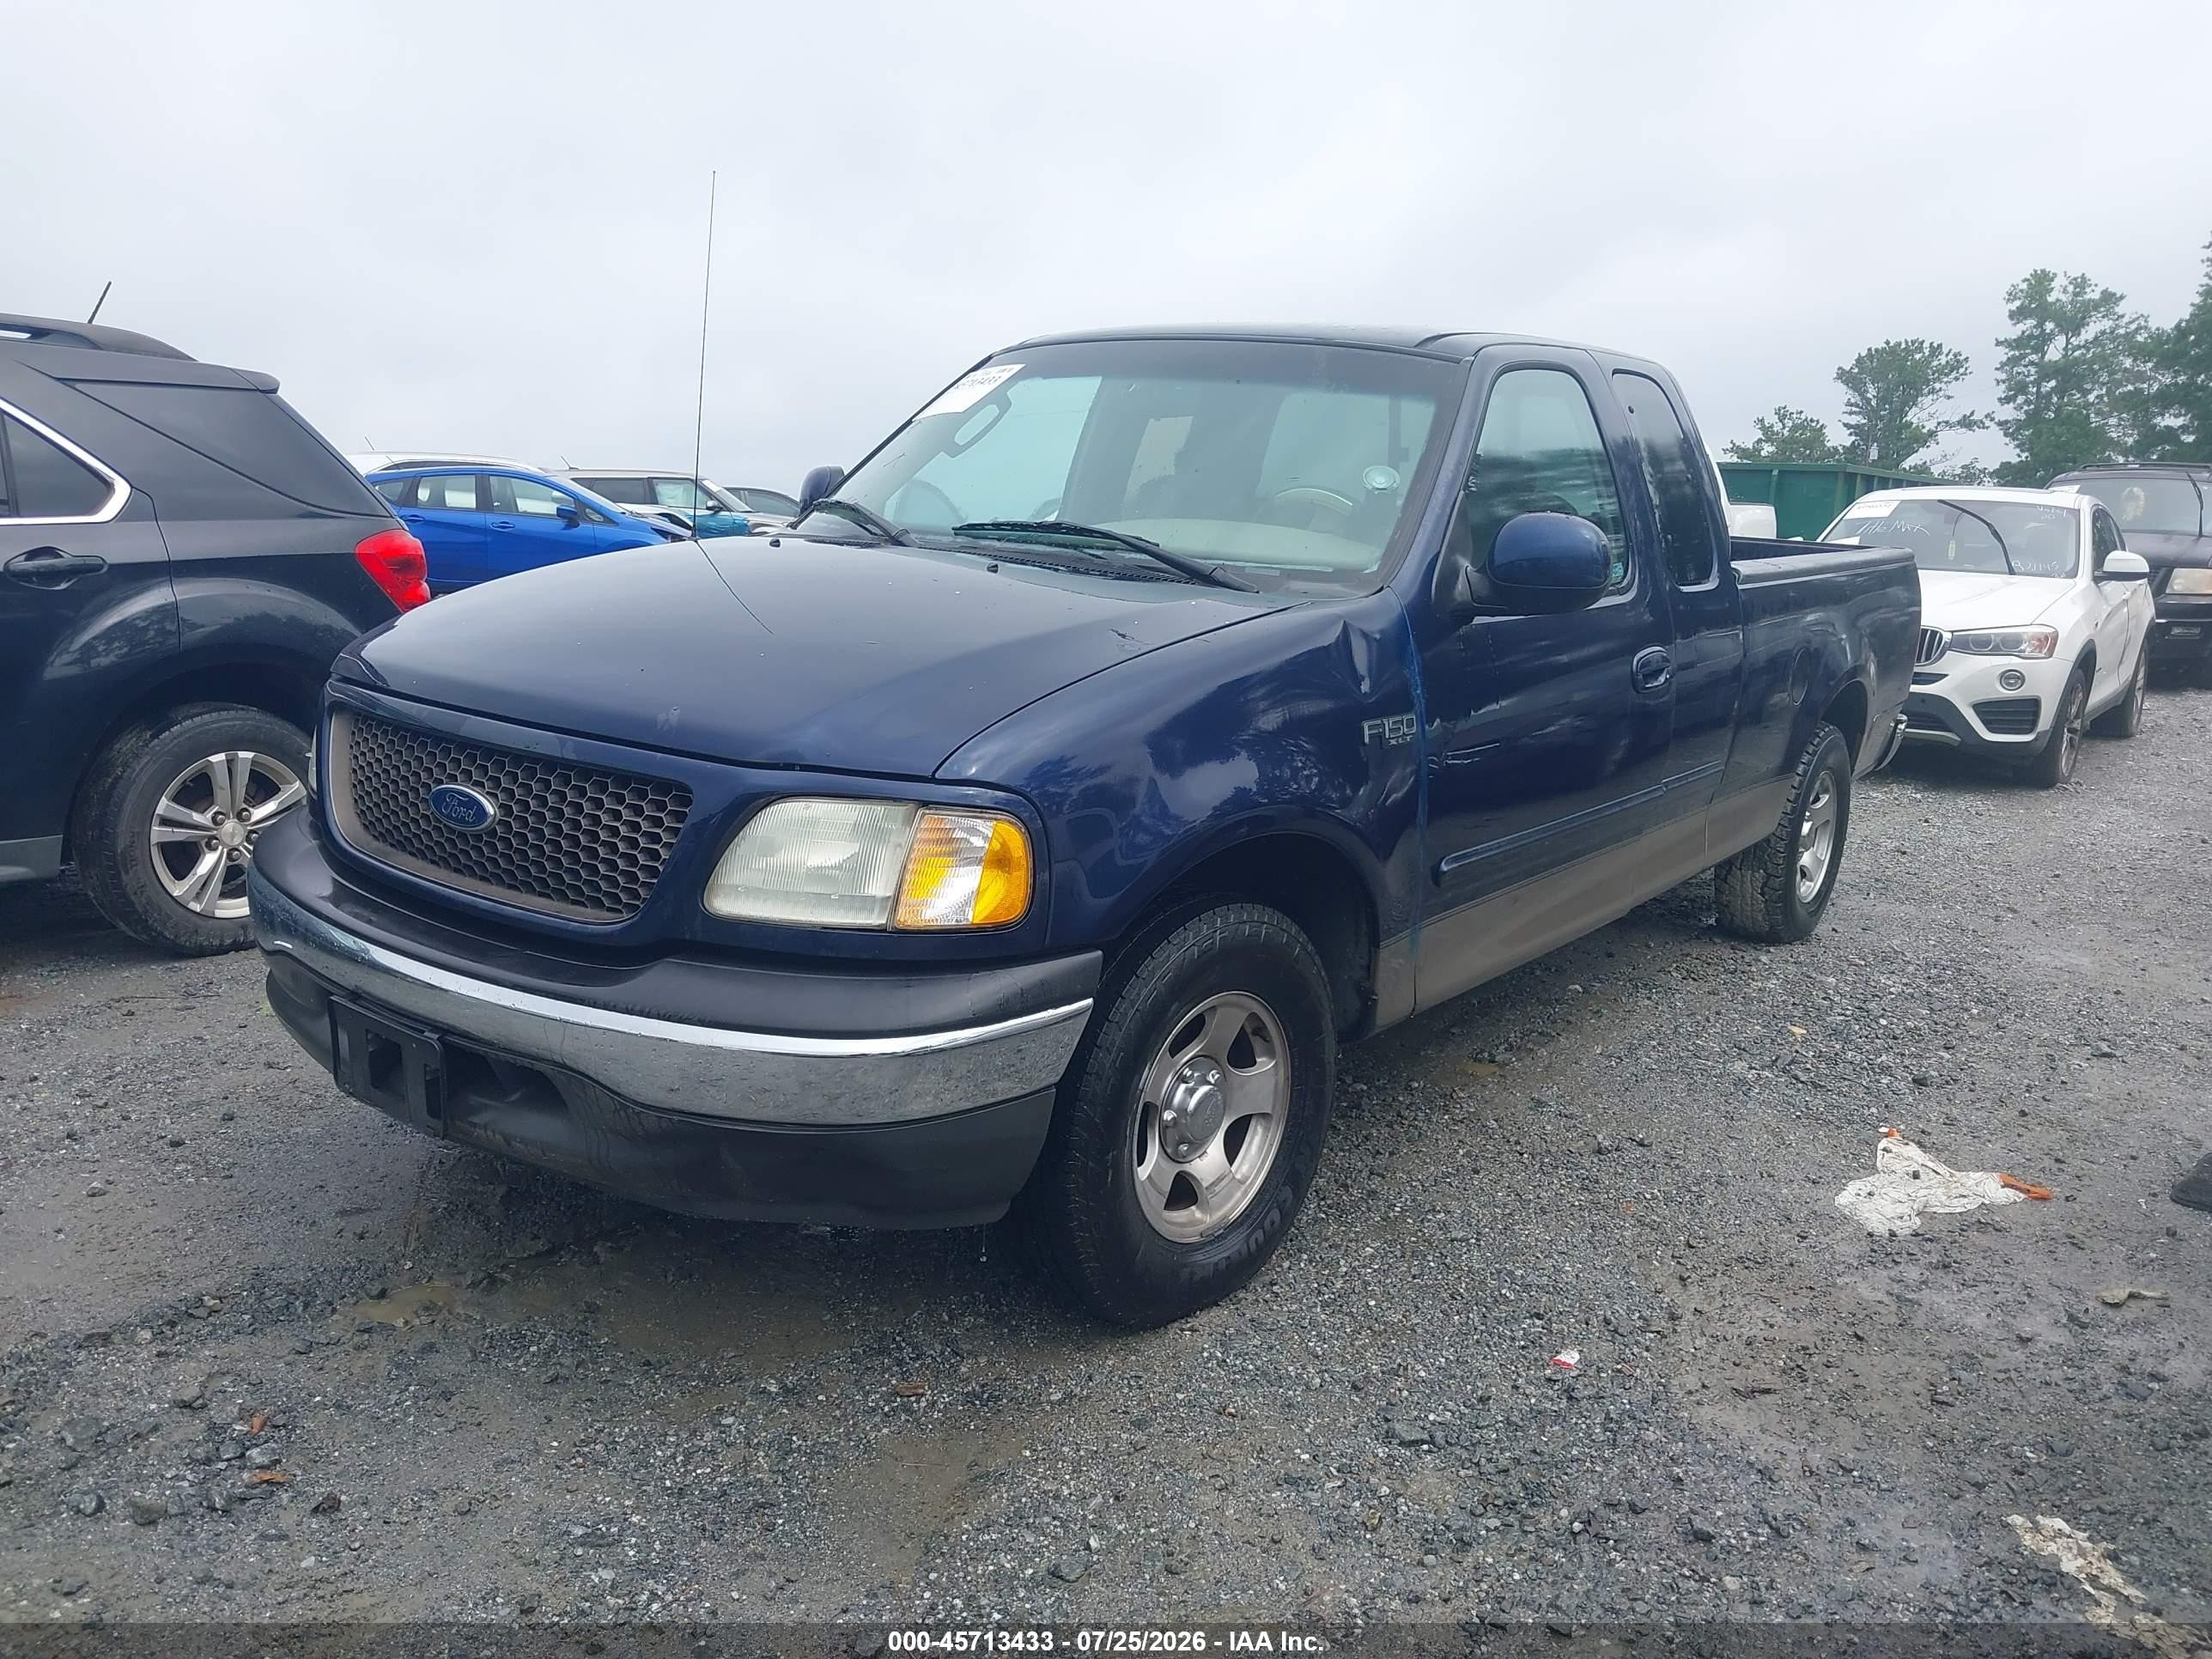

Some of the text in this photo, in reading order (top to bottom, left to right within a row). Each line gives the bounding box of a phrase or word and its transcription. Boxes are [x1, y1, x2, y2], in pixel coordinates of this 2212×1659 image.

[1362, 714, 1417, 744] F150
[1388, 735, 1413, 746] XLT
[442, 793, 477, 822] Ford
